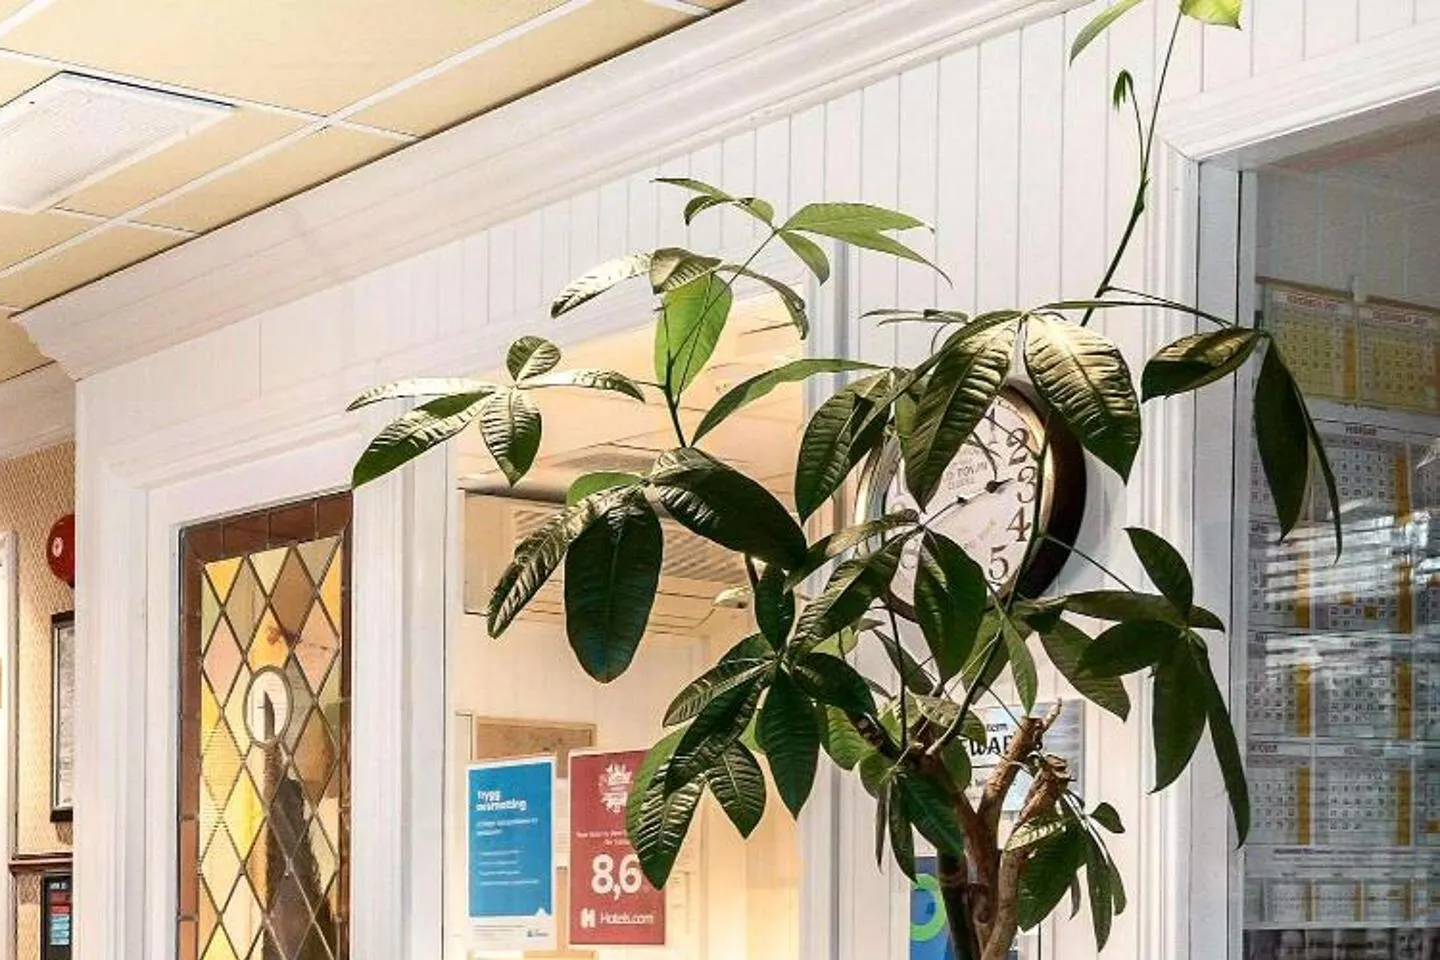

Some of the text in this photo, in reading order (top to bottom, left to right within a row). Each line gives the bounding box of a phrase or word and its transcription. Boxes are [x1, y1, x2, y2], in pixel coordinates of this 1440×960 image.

[1007, 428, 1029, 466] 2
[1017, 466, 1036, 504] 3
[1006, 507, 1031, 542] 4
[988, 545, 1009, 580] 5
[591, 853, 642, 900] 8,6
